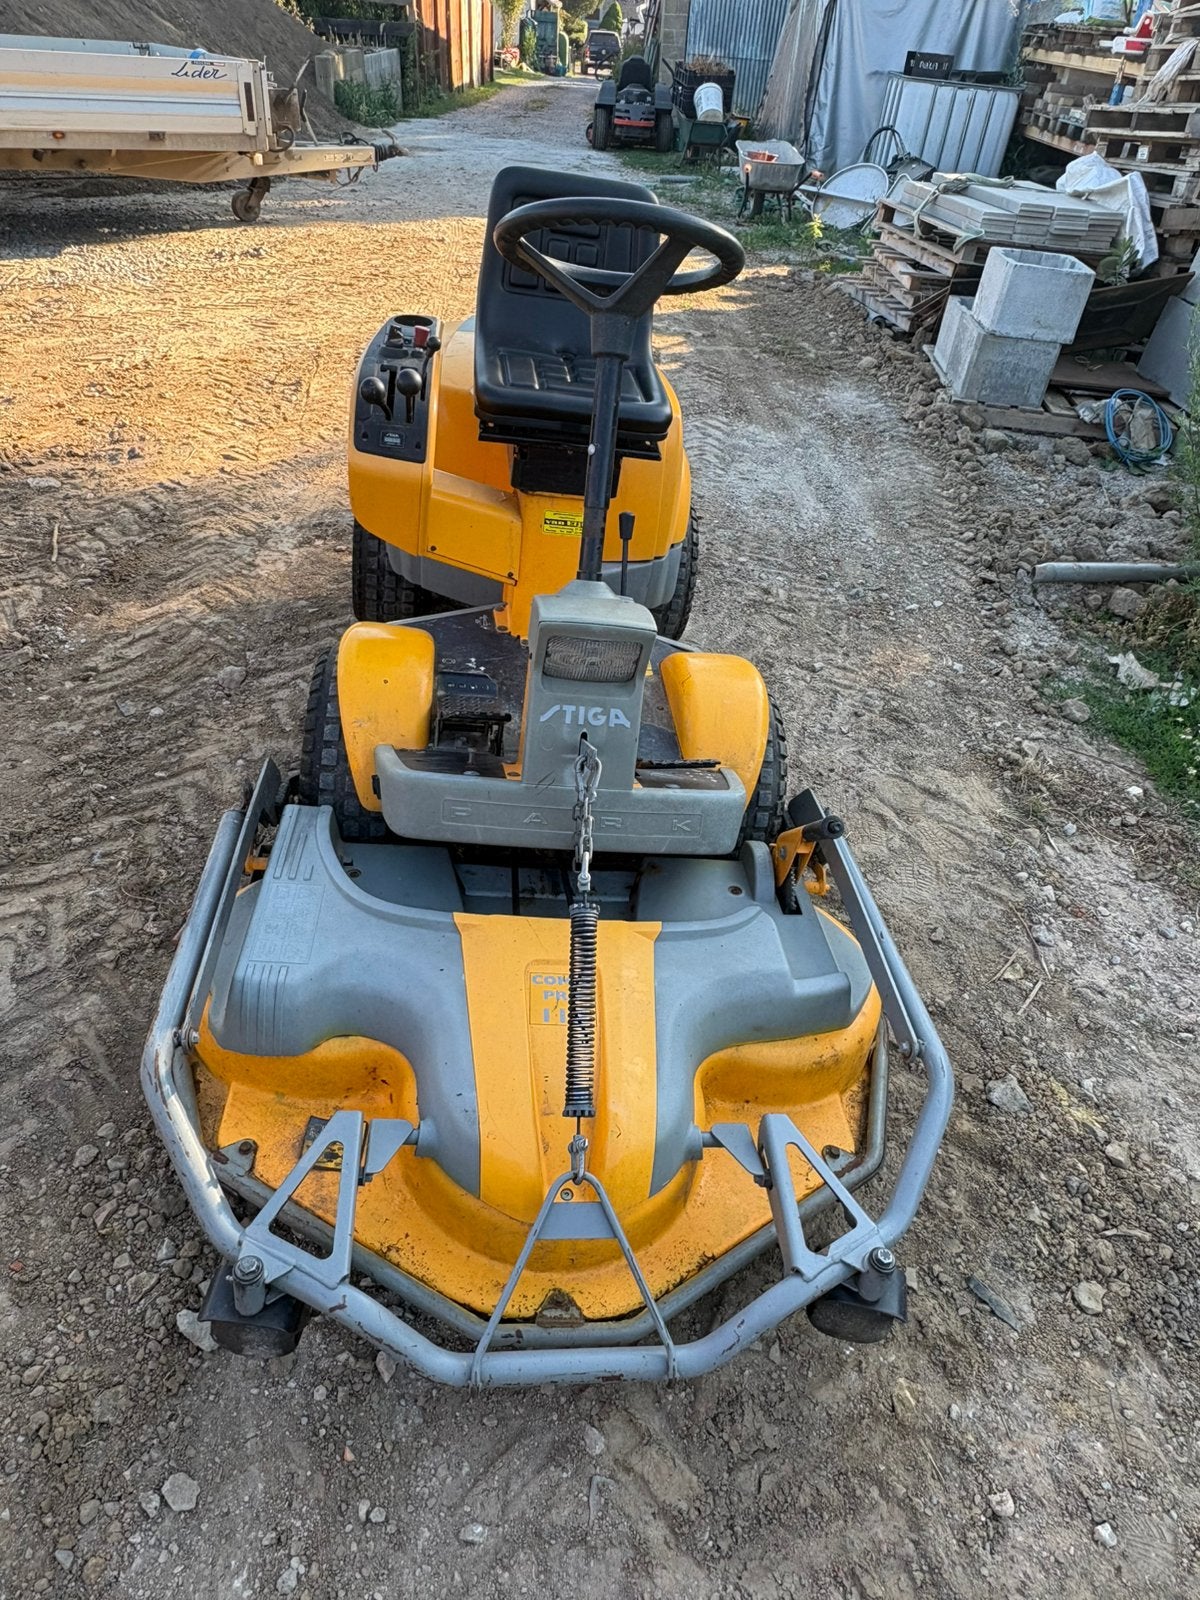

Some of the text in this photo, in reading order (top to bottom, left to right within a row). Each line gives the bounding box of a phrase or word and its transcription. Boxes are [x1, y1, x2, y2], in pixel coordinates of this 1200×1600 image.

[171, 61, 227, 79] Lider
[539, 704, 631, 728] STIGA
[450, 806, 692, 831] PARK
